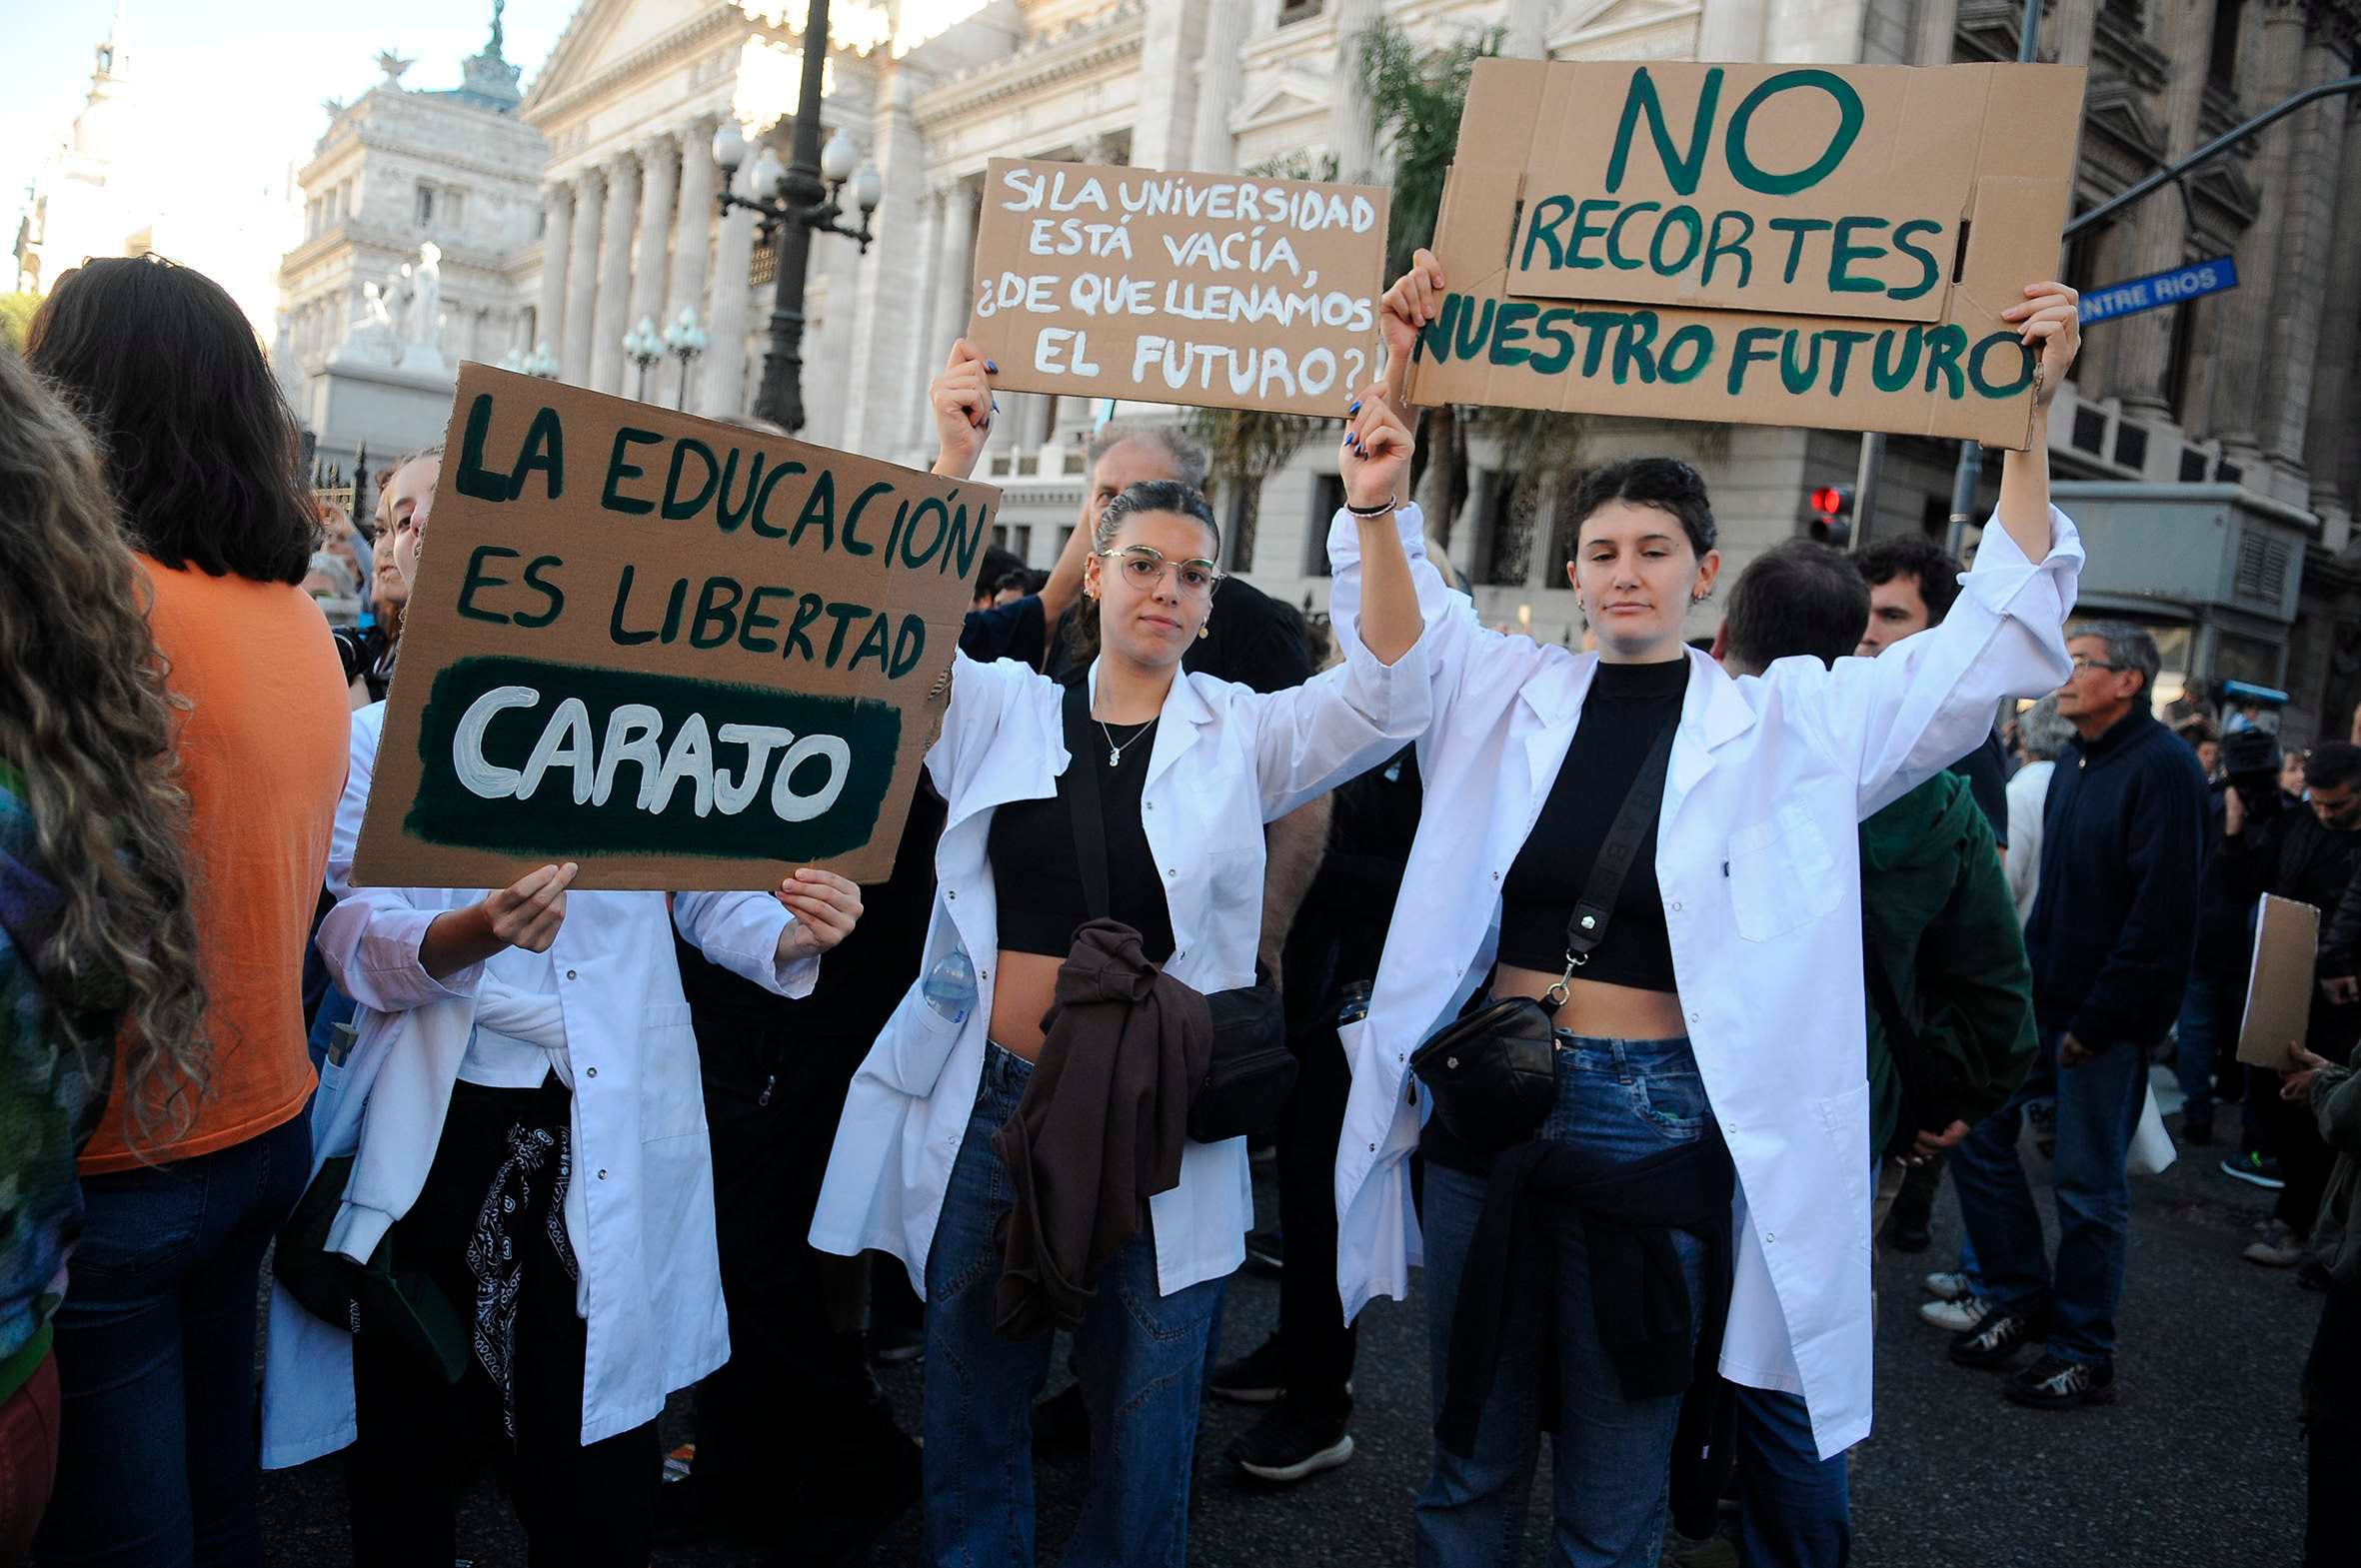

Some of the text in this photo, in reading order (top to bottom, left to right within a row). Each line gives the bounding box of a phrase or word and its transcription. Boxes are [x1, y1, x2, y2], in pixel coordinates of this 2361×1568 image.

[1605, 66, 1865, 197] NO
[1003, 168, 1047, 213] SI
[1050, 171, 1110, 212] LA
[1029, 213, 1318, 289] ESTÁ VACÍA,
[1520, 194, 1943, 301] RECORTES
[2154, 267, 2217, 301] RIOS
[976, 271, 1374, 333] ¿DE QUE LLENAMOS
[1413, 292, 2037, 401] NUESTRO FUTURO
[1035, 326, 1365, 402] EL FUTURO?
[456, 393, 988, 580] LA EDUCACIÓN
[457, 544, 926, 680] ES LIBERTAD
[453, 686, 851, 822] CARAJO
